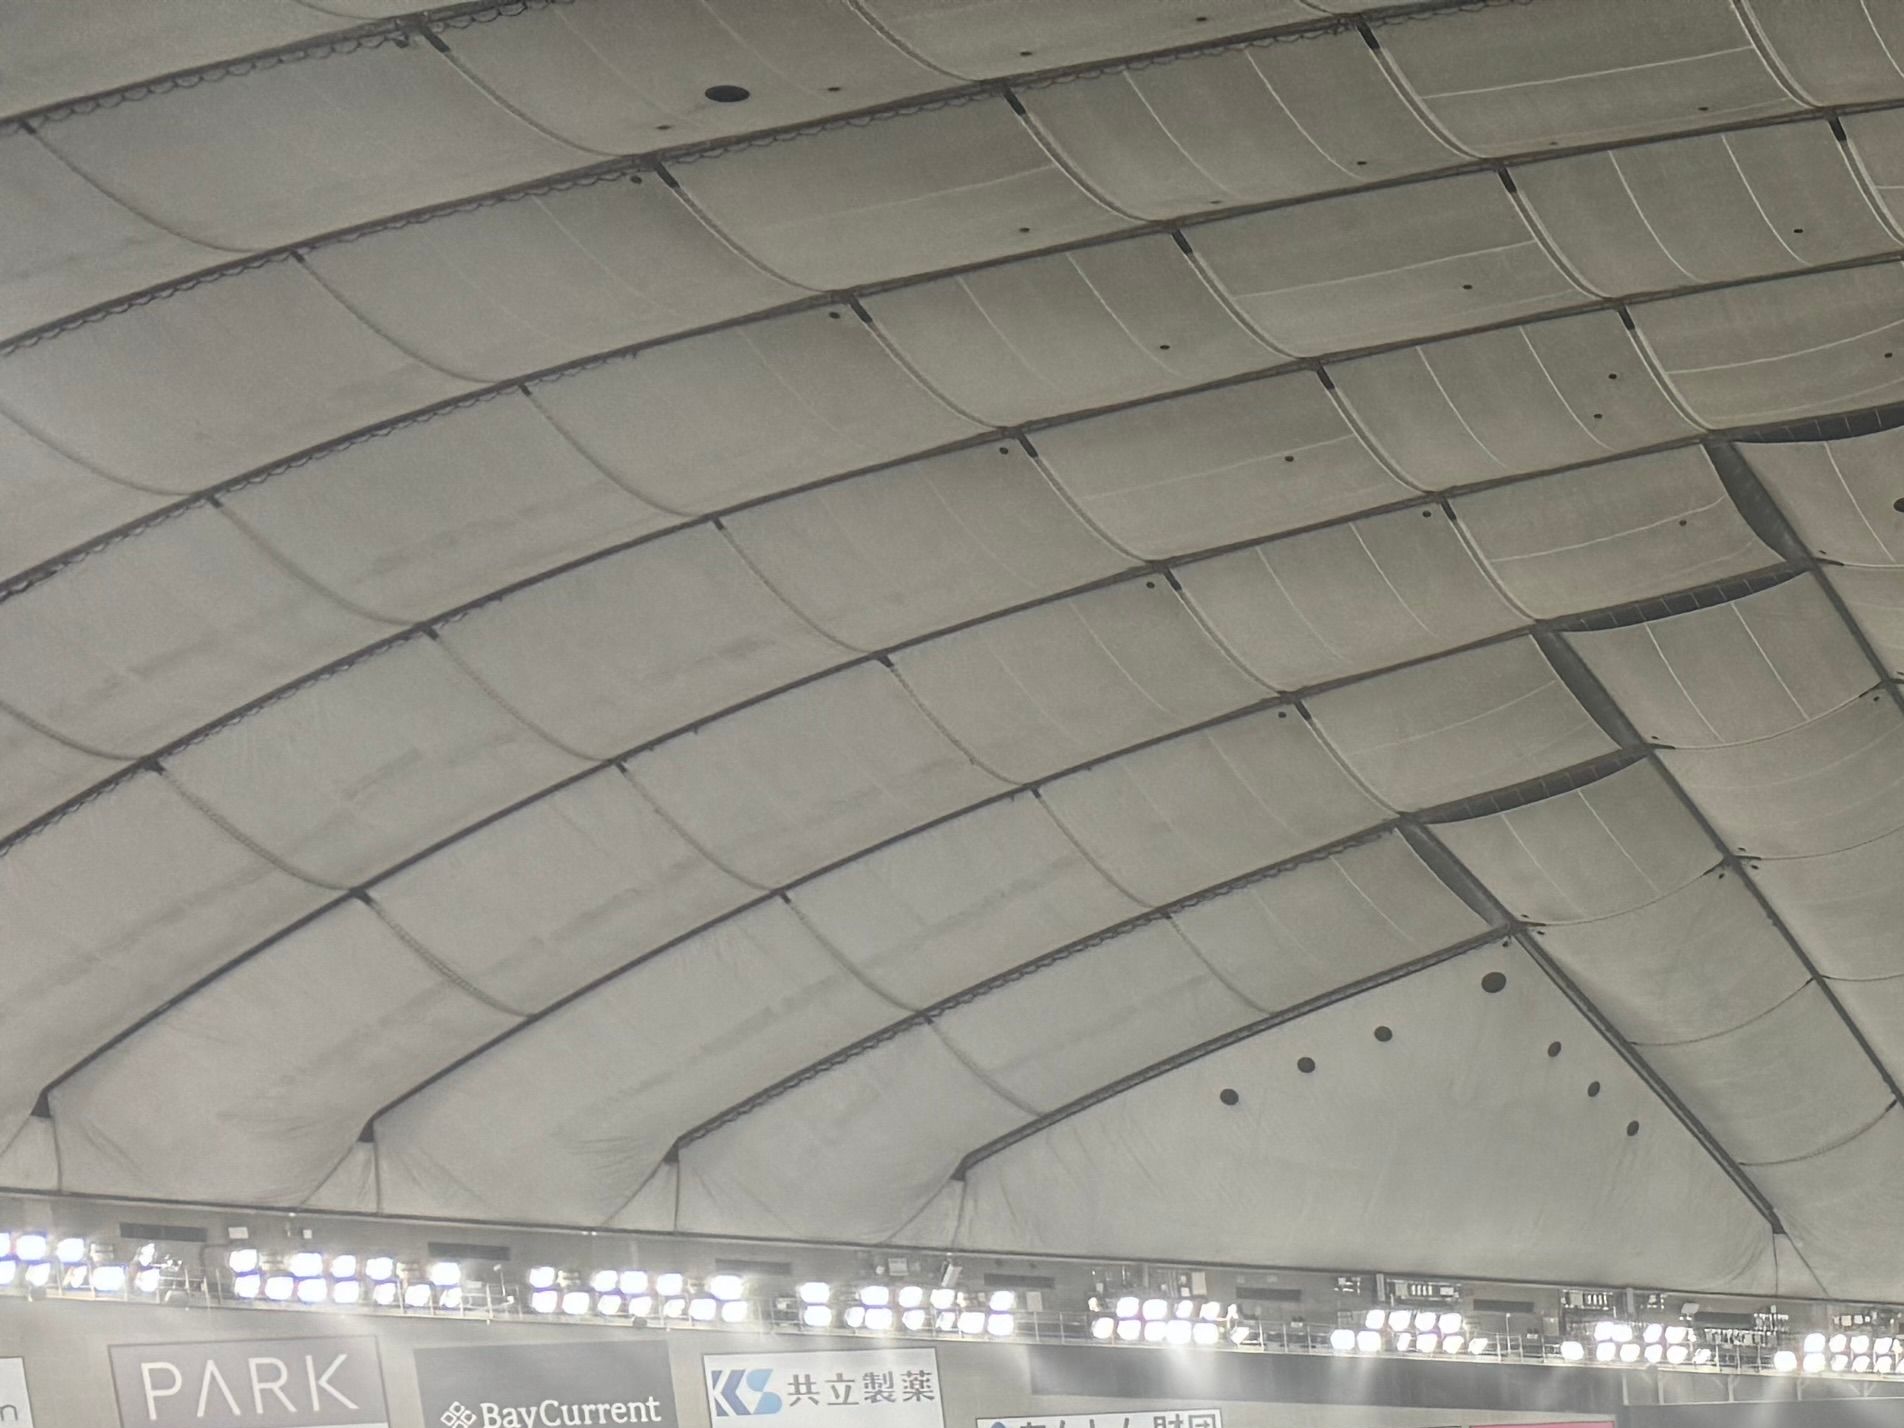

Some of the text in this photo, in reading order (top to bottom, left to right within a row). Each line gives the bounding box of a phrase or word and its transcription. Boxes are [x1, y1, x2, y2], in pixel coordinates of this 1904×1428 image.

[141, 1353, 360, 1421] PARK
[787, 1369, 935, 1407] 共立製薬
